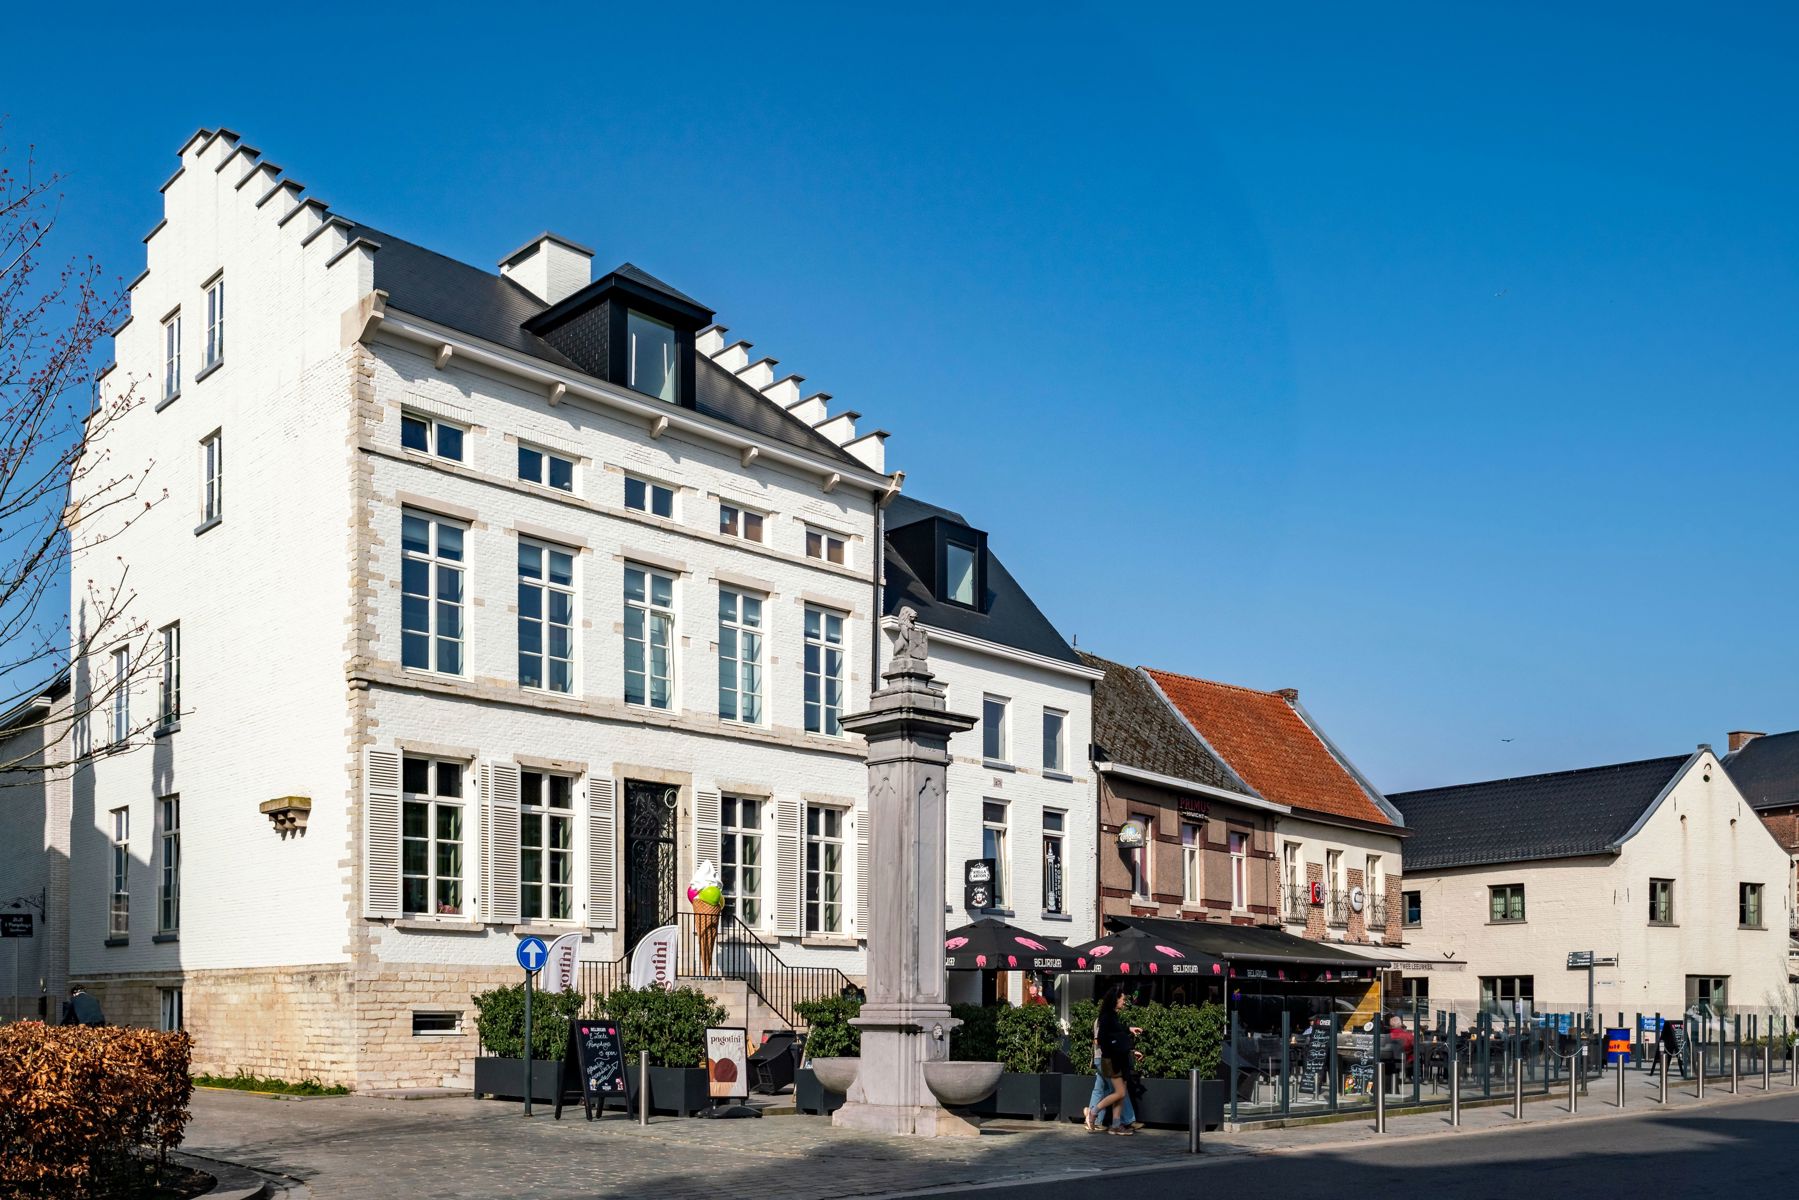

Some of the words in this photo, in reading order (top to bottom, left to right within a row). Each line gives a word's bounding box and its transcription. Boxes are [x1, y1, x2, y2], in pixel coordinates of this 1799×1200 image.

[1179, 797, 1211, 812] PRIMUS
[560, 946, 572, 991] gotini
[651, 941, 672, 991] gotini
[1034, 958, 1062, 968] DELIRIUM
[1172, 964, 1198, 974] DELIRIUM
[711, 1036, 741, 1045] pagotini
